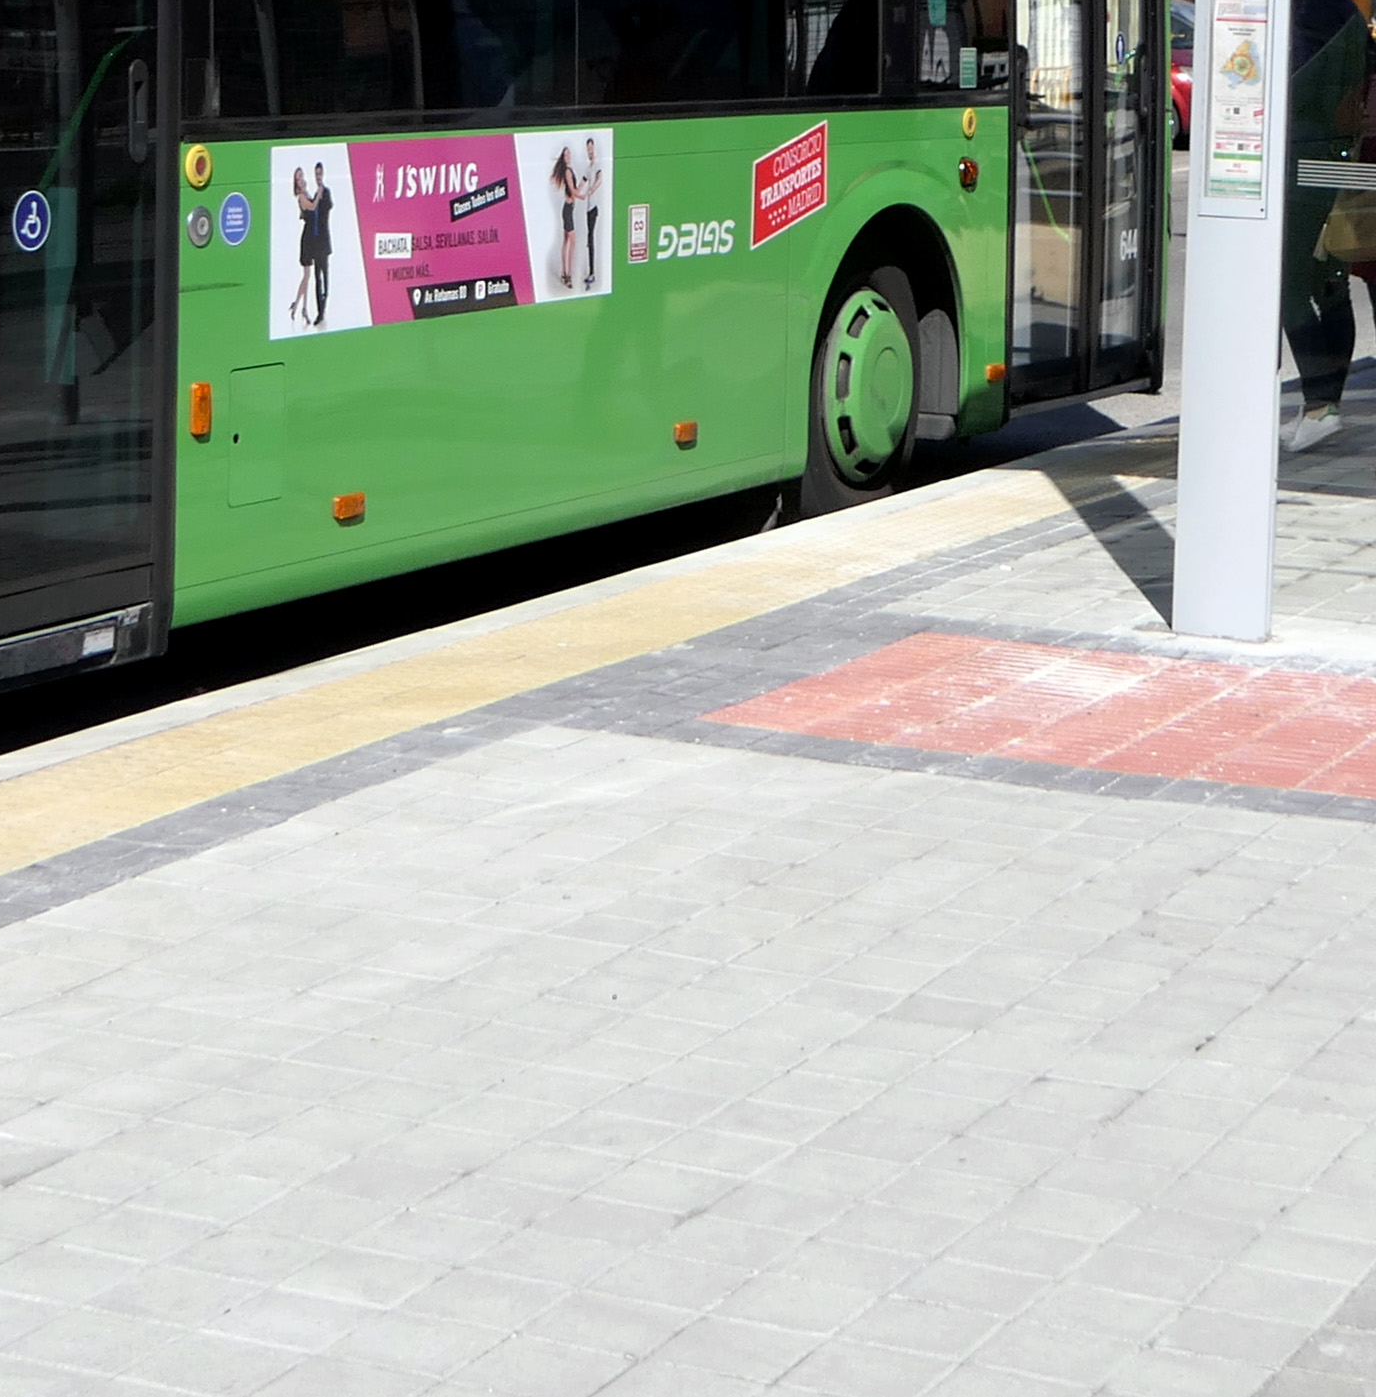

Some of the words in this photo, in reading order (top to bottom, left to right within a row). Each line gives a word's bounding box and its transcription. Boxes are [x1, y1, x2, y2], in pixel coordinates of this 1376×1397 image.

[773, 132, 822, 177] CONSORCIO
[760, 157, 822, 210] TRANSPORTES
[788, 182, 822, 218] MADRID
[1120, 228, 1138, 261] 644
[434, 288, 459, 302] Retamas
[487, 279, 510, 295] Gratuito
